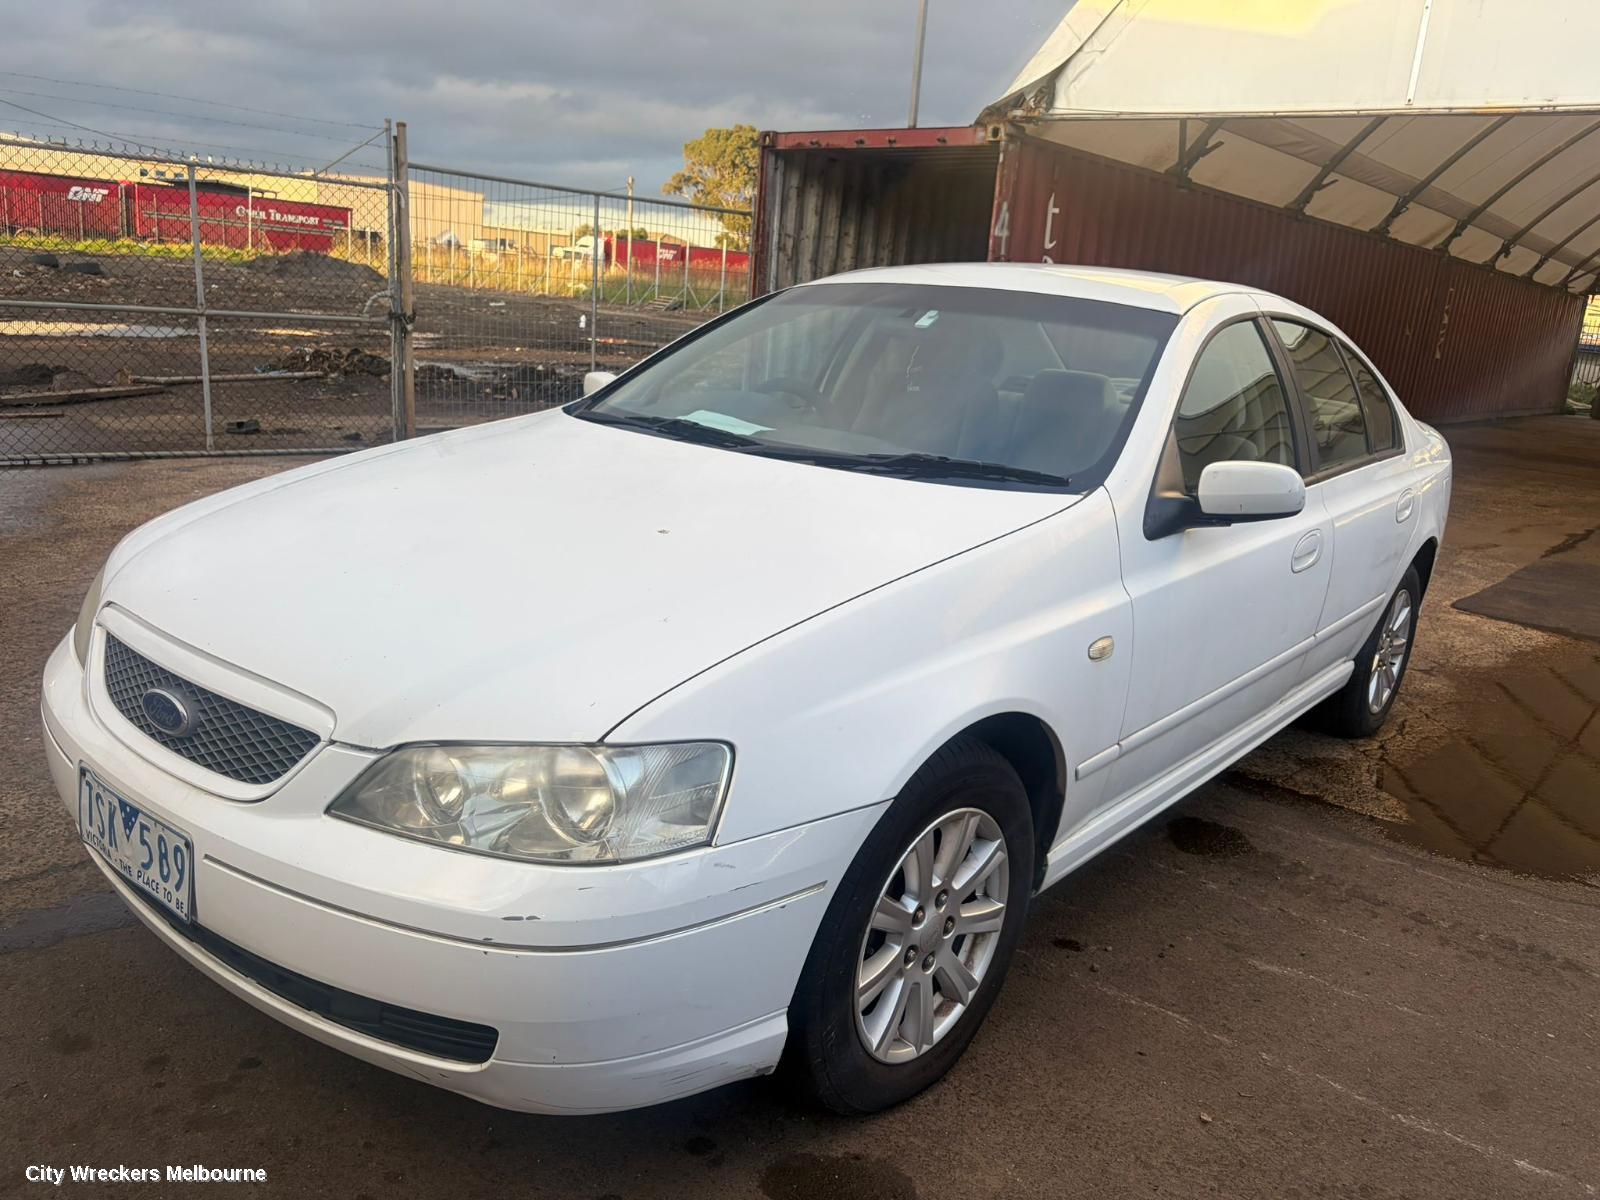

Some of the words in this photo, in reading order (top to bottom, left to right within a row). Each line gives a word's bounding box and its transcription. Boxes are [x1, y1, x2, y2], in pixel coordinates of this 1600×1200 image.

[268, 208, 320, 225] TRANSPORT
[86, 779, 118, 853] TSK
[139, 820, 186, 893] 589
[119, 858, 133, 877] THE
[137, 870, 160, 894] PLACE
[163, 886, 173, 903] TO
